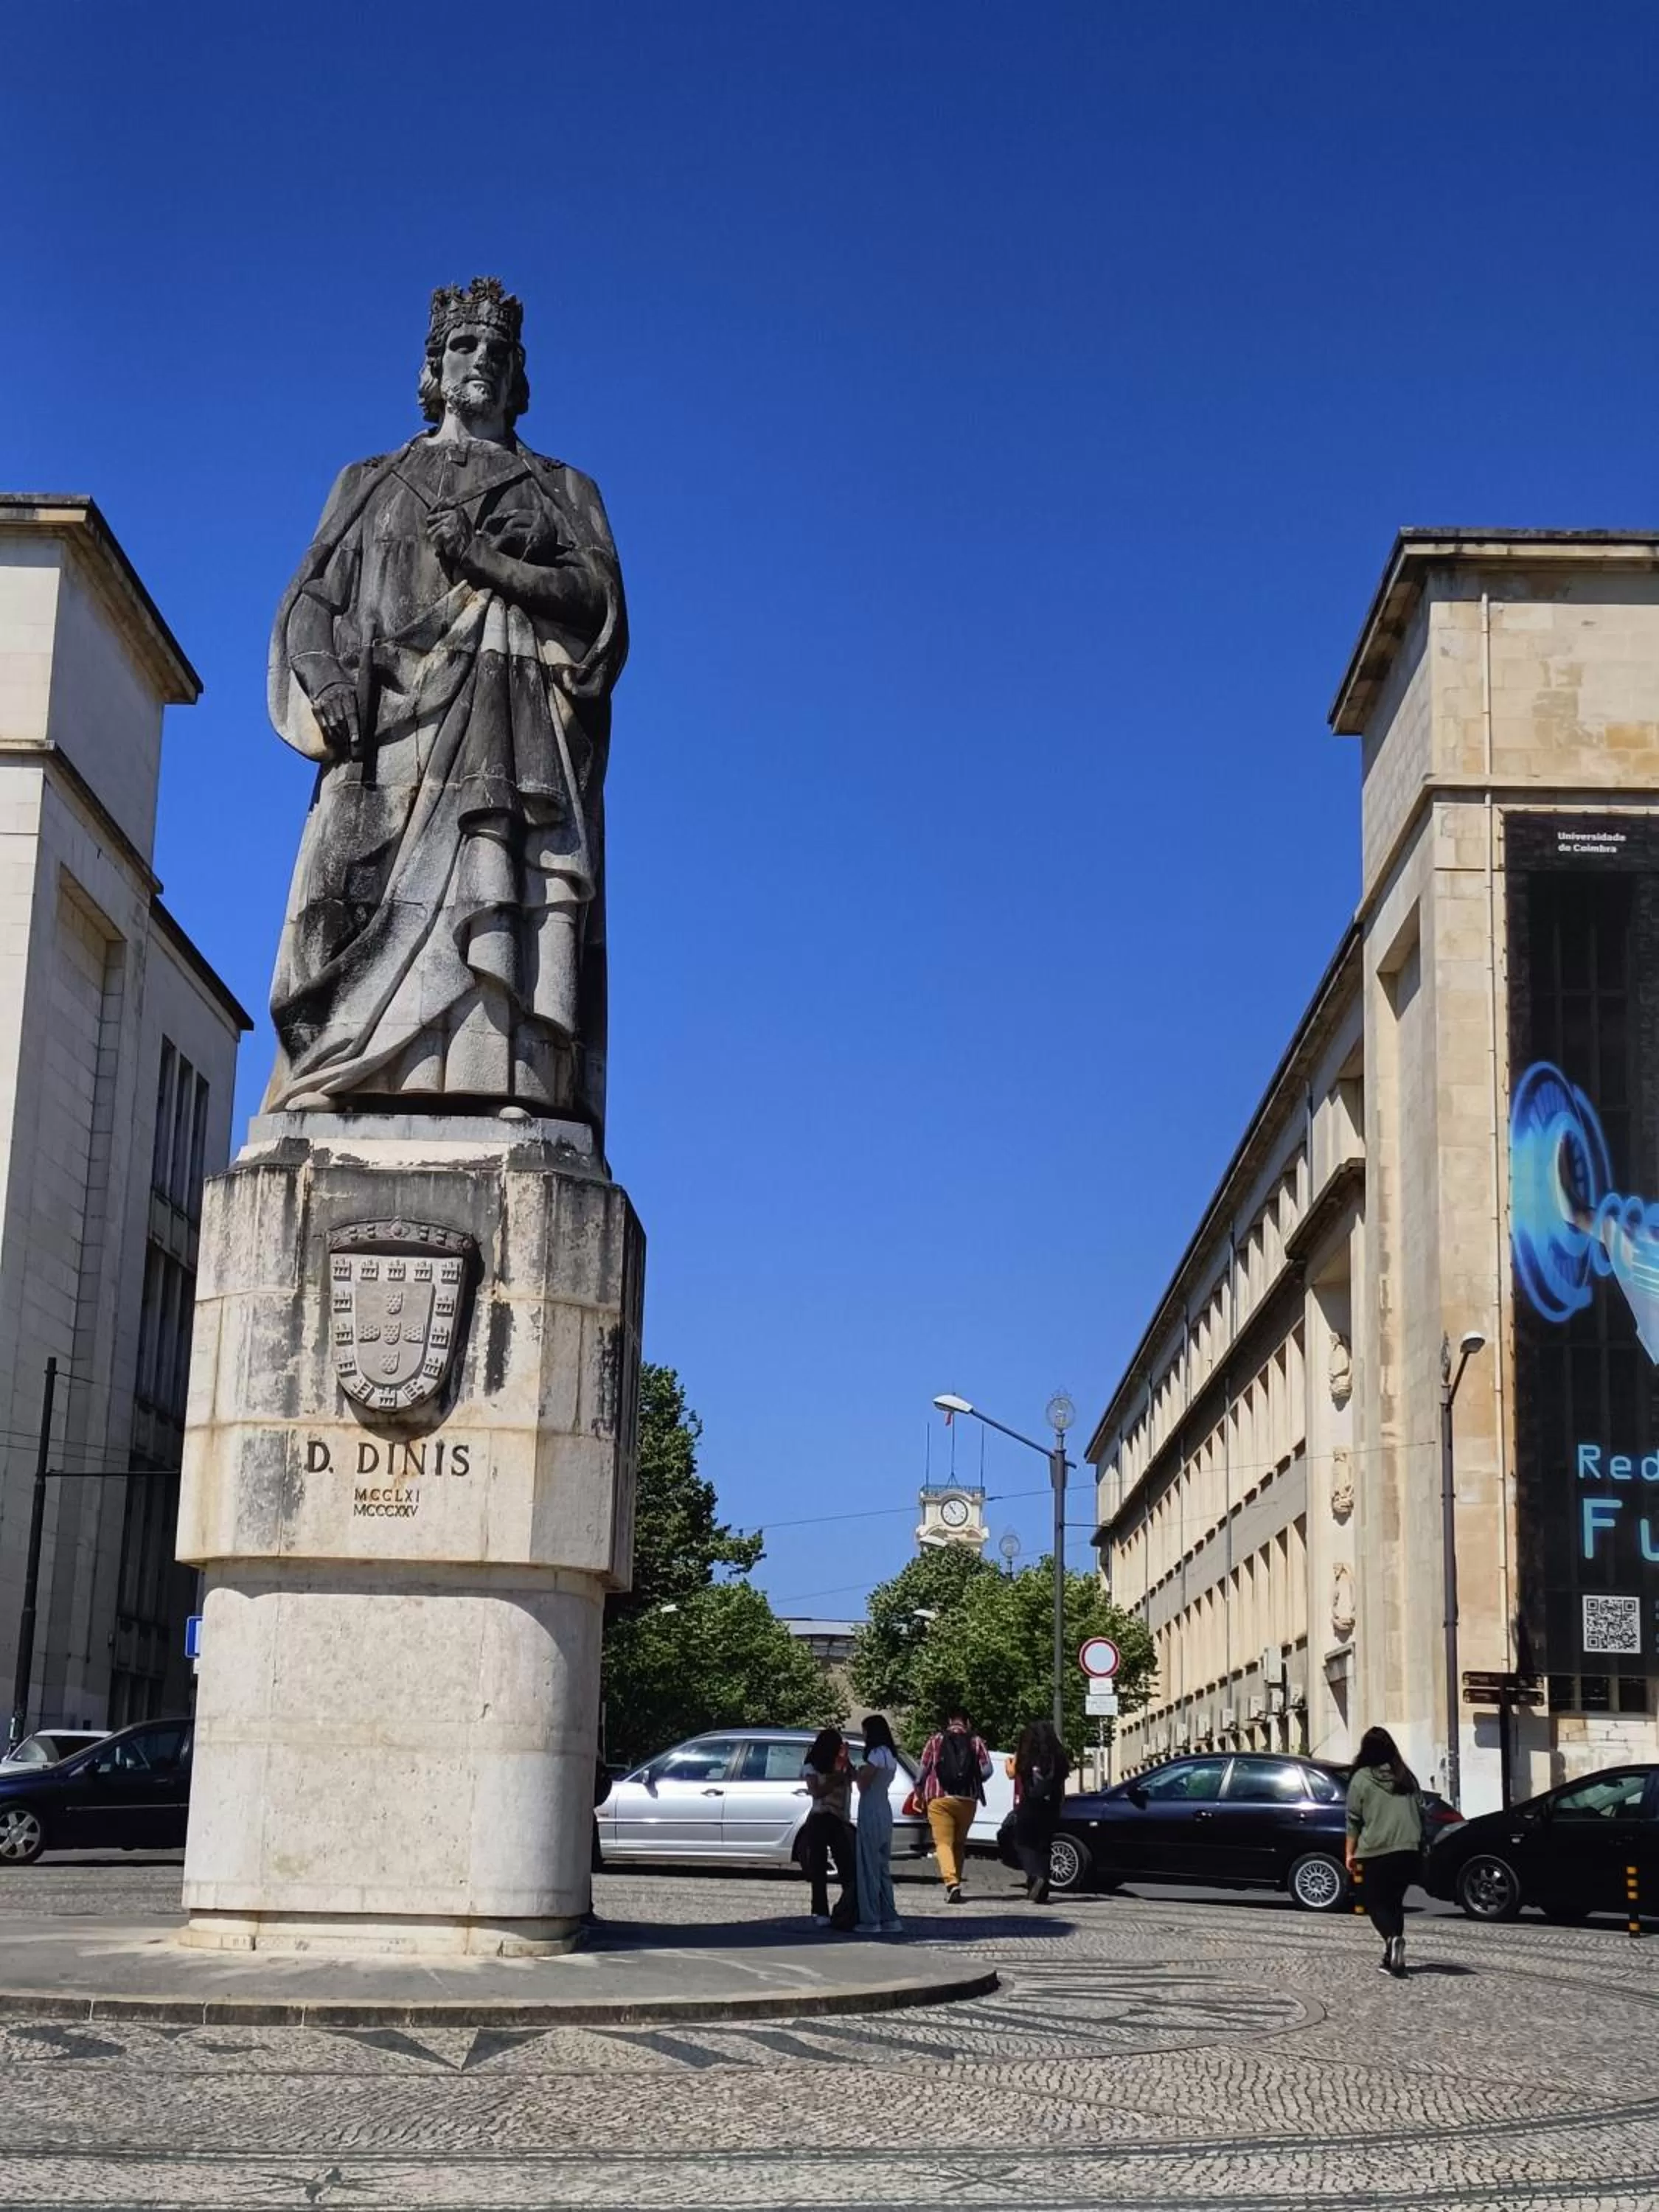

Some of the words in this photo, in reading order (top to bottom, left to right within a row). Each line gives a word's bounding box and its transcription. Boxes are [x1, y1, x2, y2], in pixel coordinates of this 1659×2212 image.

[1557, 832, 1627, 842] Universidade
[1558, 844, 1571, 852] de
[1573, 844, 1618, 853] Coimbra
[306, 1441, 334, 1474] D.
[356, 1441, 470, 1477] DINIS
[354, 1488, 420, 1503] MCCLXI
[354, 1503, 419, 1517] MCCCXXV
